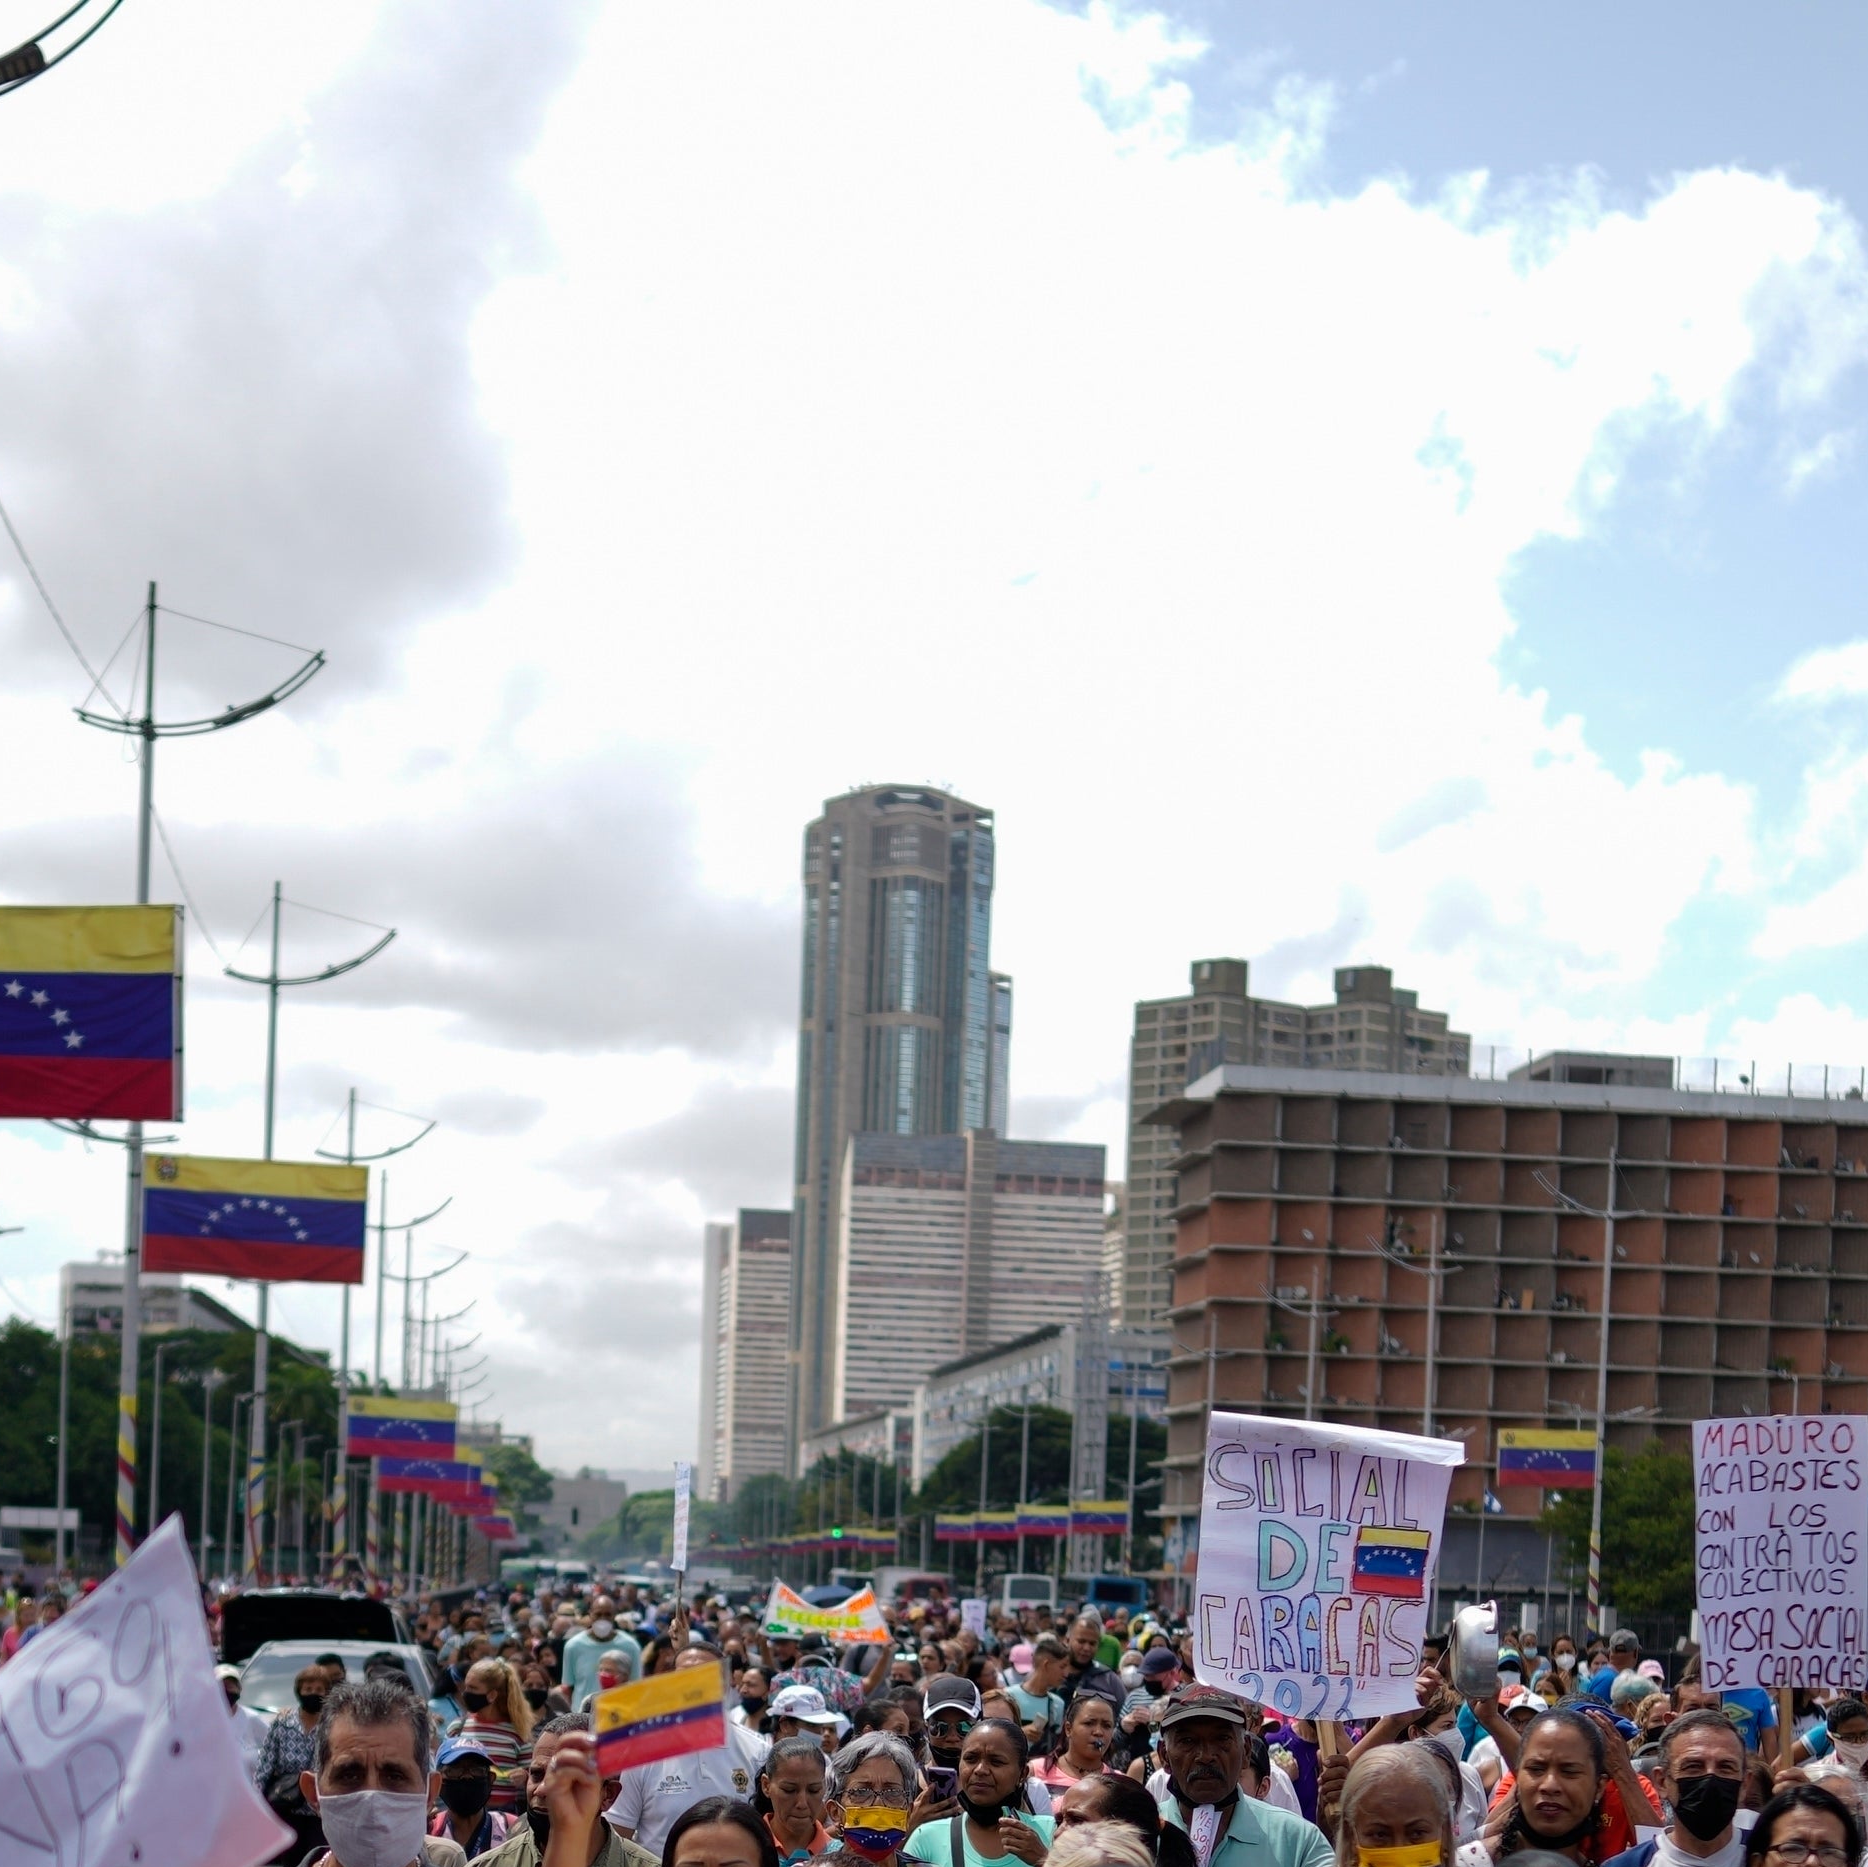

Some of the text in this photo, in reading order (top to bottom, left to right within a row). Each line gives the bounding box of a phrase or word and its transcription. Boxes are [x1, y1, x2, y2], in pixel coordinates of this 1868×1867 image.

[1701, 1419, 1854, 1459] MADURO
[1208, 1443, 1418, 1529] SOCIAL
[1699, 1459, 1861, 1497] ACABASTES
[1696, 1502, 1827, 1534] CON LOS
[1257, 1519, 1351, 1594] DE
[1698, 1529, 1858, 1570] CONTRATOS
[1200, 1592, 1425, 1678] CARACAS
[1701, 1606, 1774, 1656] MESA
[1706, 1653, 1865, 1689] DE CARACAS
